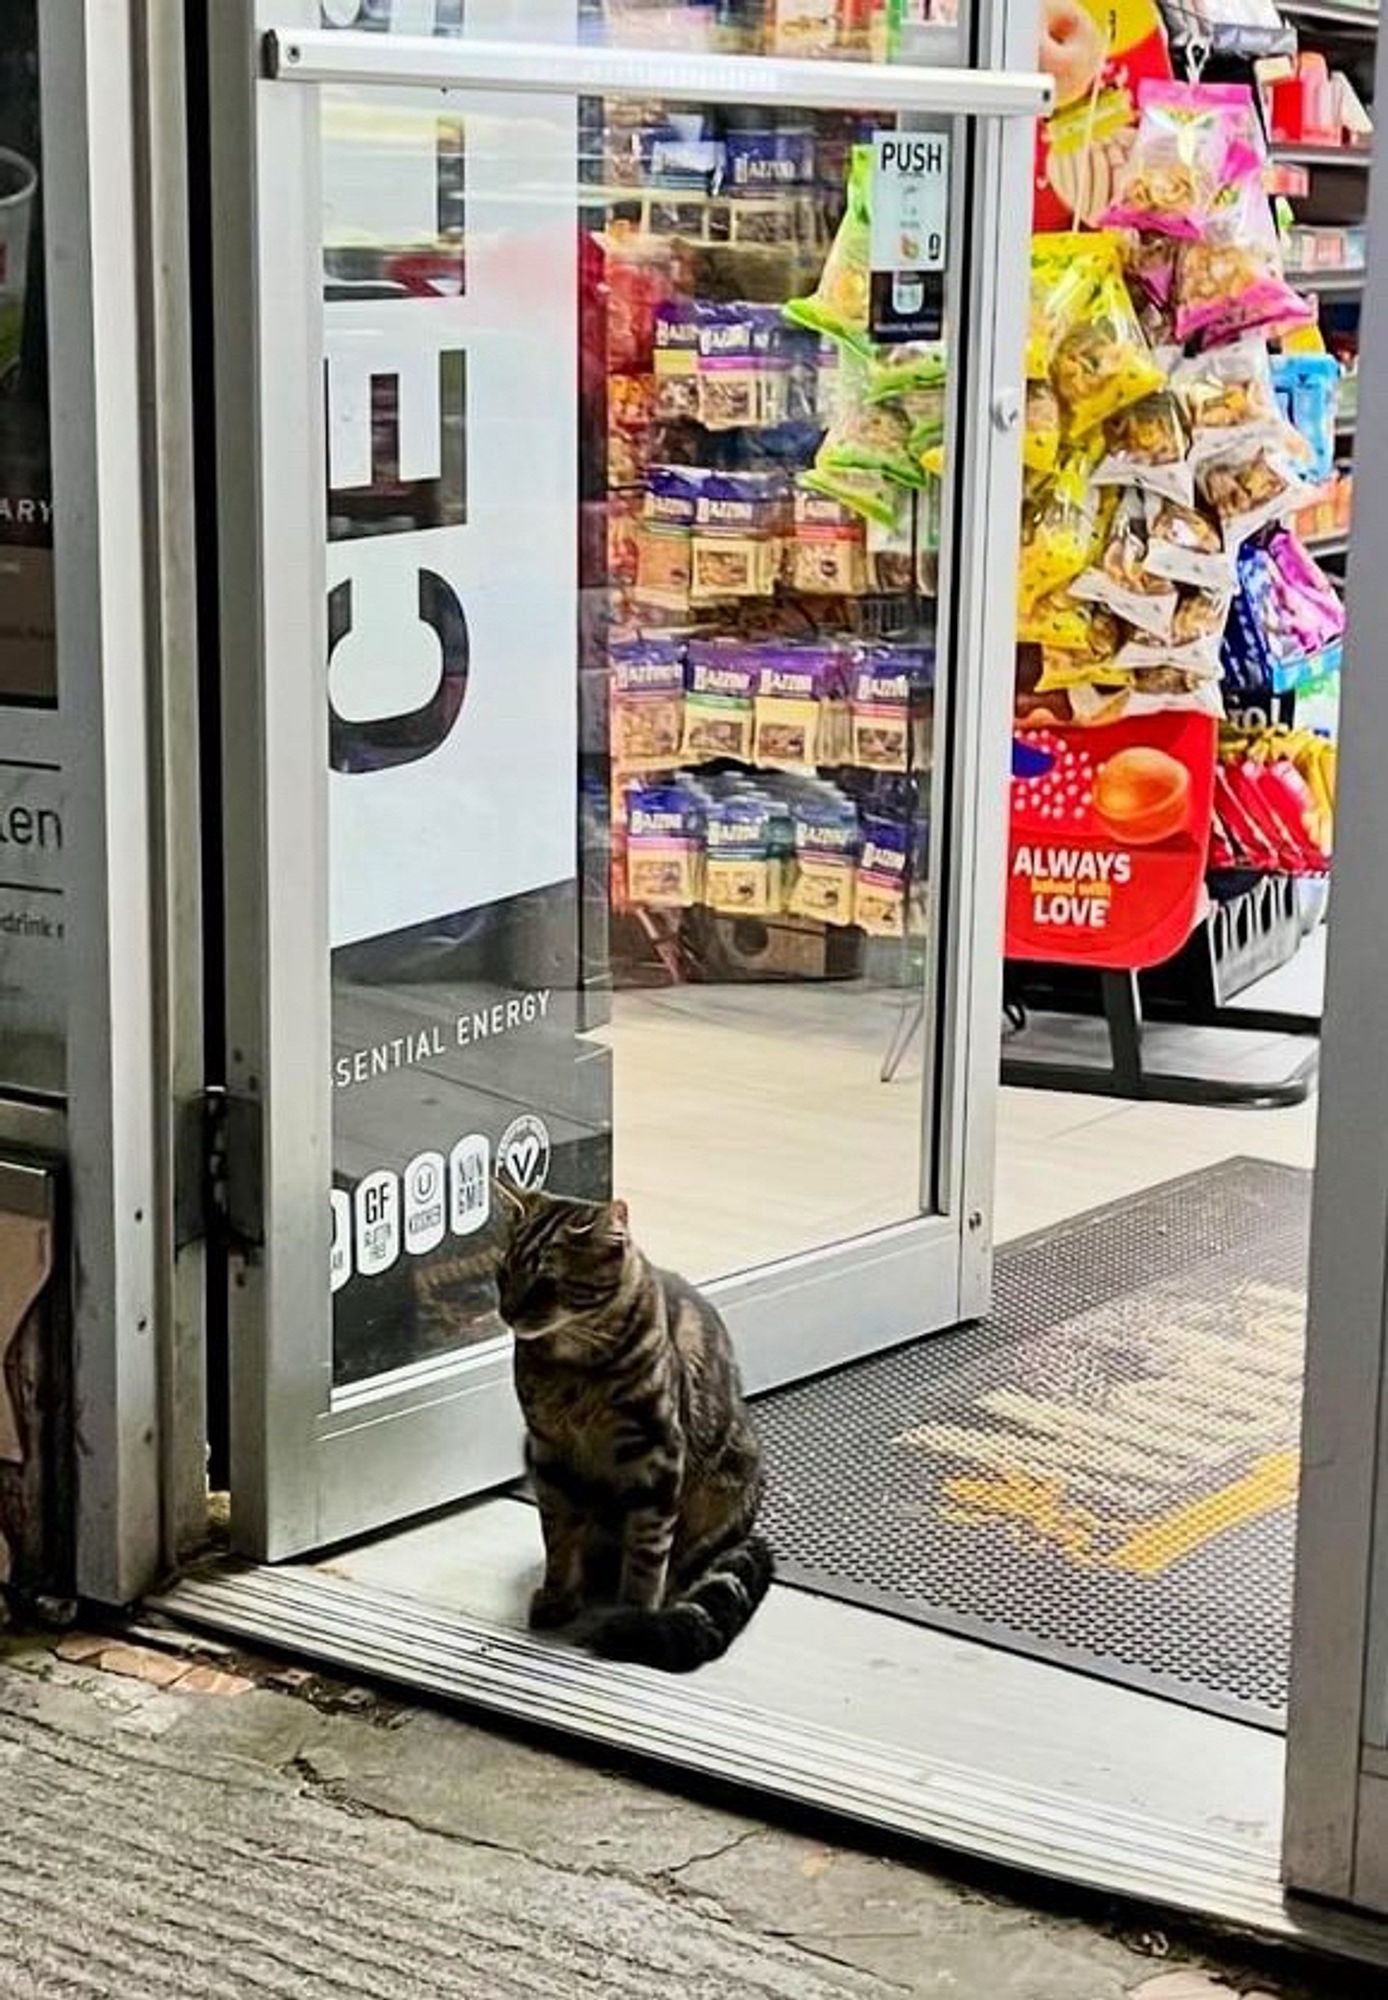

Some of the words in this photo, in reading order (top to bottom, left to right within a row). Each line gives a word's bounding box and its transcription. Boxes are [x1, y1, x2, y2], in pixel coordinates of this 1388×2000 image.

[880, 141, 943, 174] PUSH
[323, 0, 469, 774] CEL
[0, 806, 62, 849] en
[1013, 846, 1132, 884] ALWAYS
[1033, 894, 1111, 929] LOVE
[329, 1026, 446, 1088] SENTIAL
[456, 988, 552, 1046] ENERGY
[364, 1180, 390, 1225] GF
